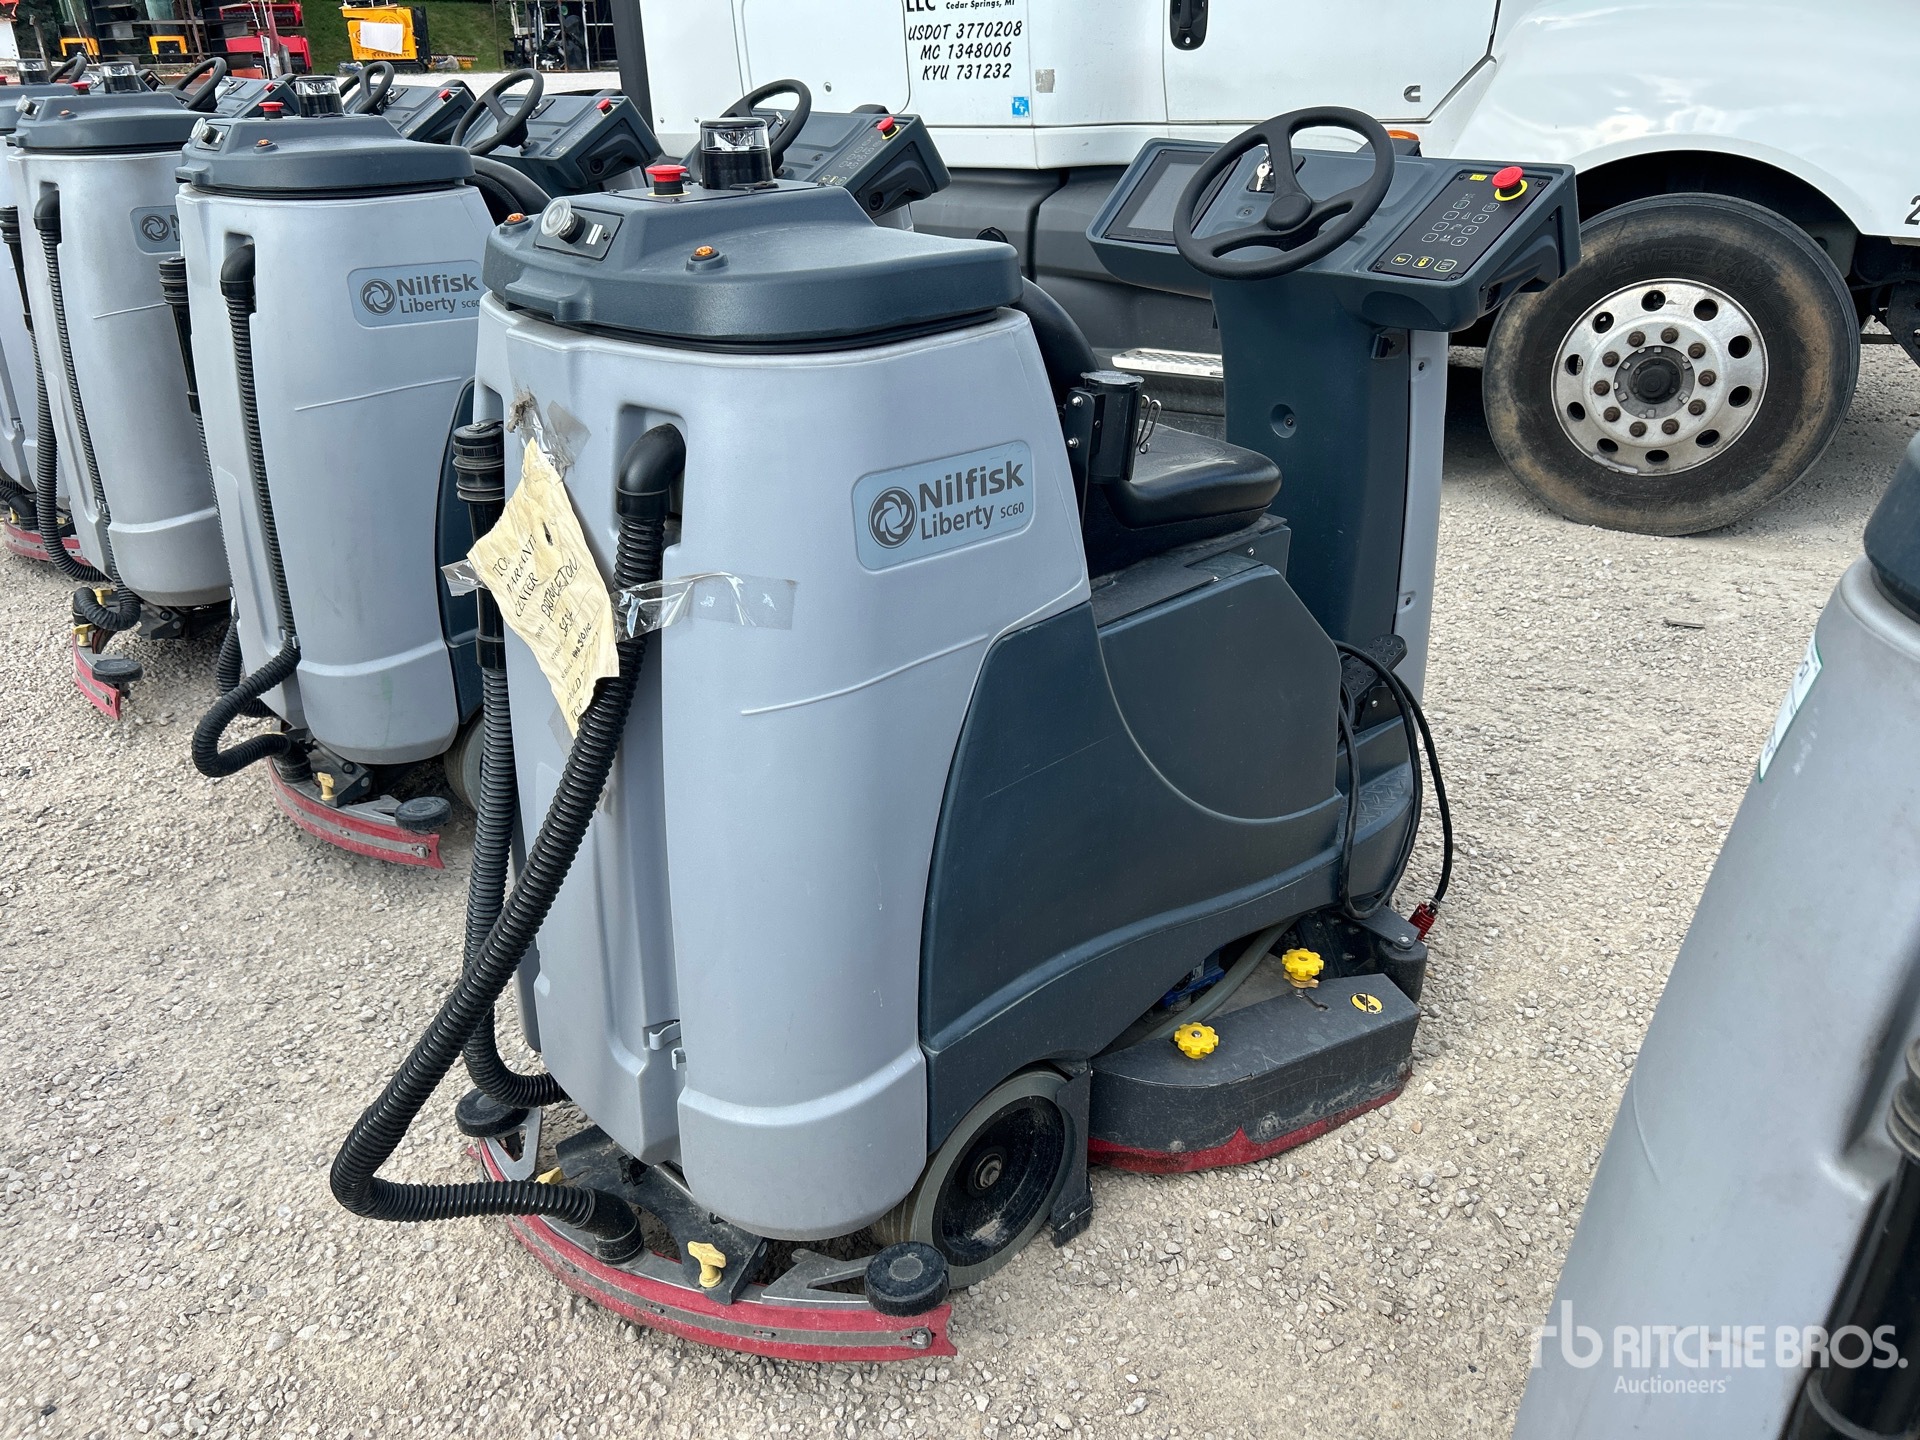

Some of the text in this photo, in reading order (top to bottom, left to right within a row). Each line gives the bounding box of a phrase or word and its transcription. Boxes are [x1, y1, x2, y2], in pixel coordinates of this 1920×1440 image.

[946, 1, 968, 9] Cedar
[970, 0, 1002, 10] Springs,
[908, 20, 1023, 41] USDOT 3770208
[920, 41, 1012, 60] MC 1348006
[922, 63, 1012, 80] KYU 731232
[396, 273, 479, 297] Nilfisk
[400, 297, 456, 314] Liberty
[919, 460, 1025, 512] Nilfisk
[920, 501, 1025, 540] Liberty SC60
